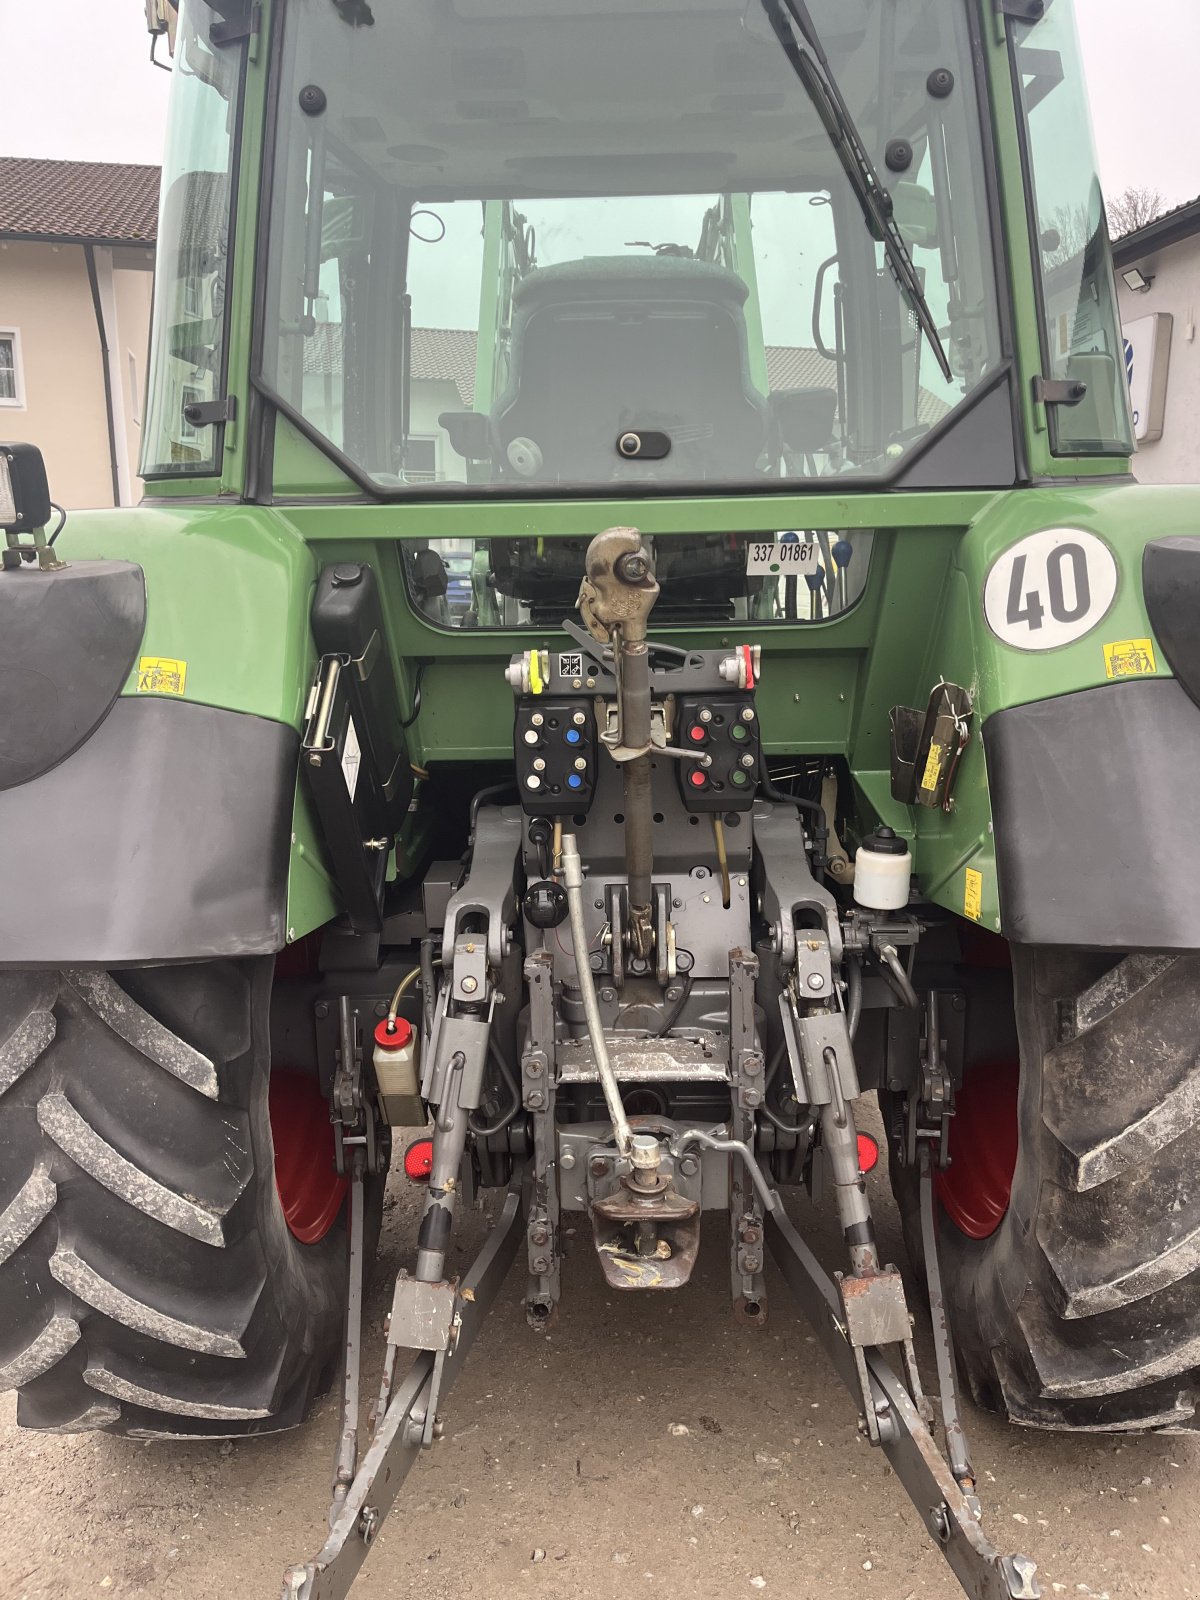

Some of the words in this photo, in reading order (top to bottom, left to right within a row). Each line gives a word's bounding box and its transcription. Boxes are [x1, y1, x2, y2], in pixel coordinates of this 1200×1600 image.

[754, 544, 774, 561] 337
[780, 544, 813, 561] 01861
[1006, 543, 1091, 631] 40
